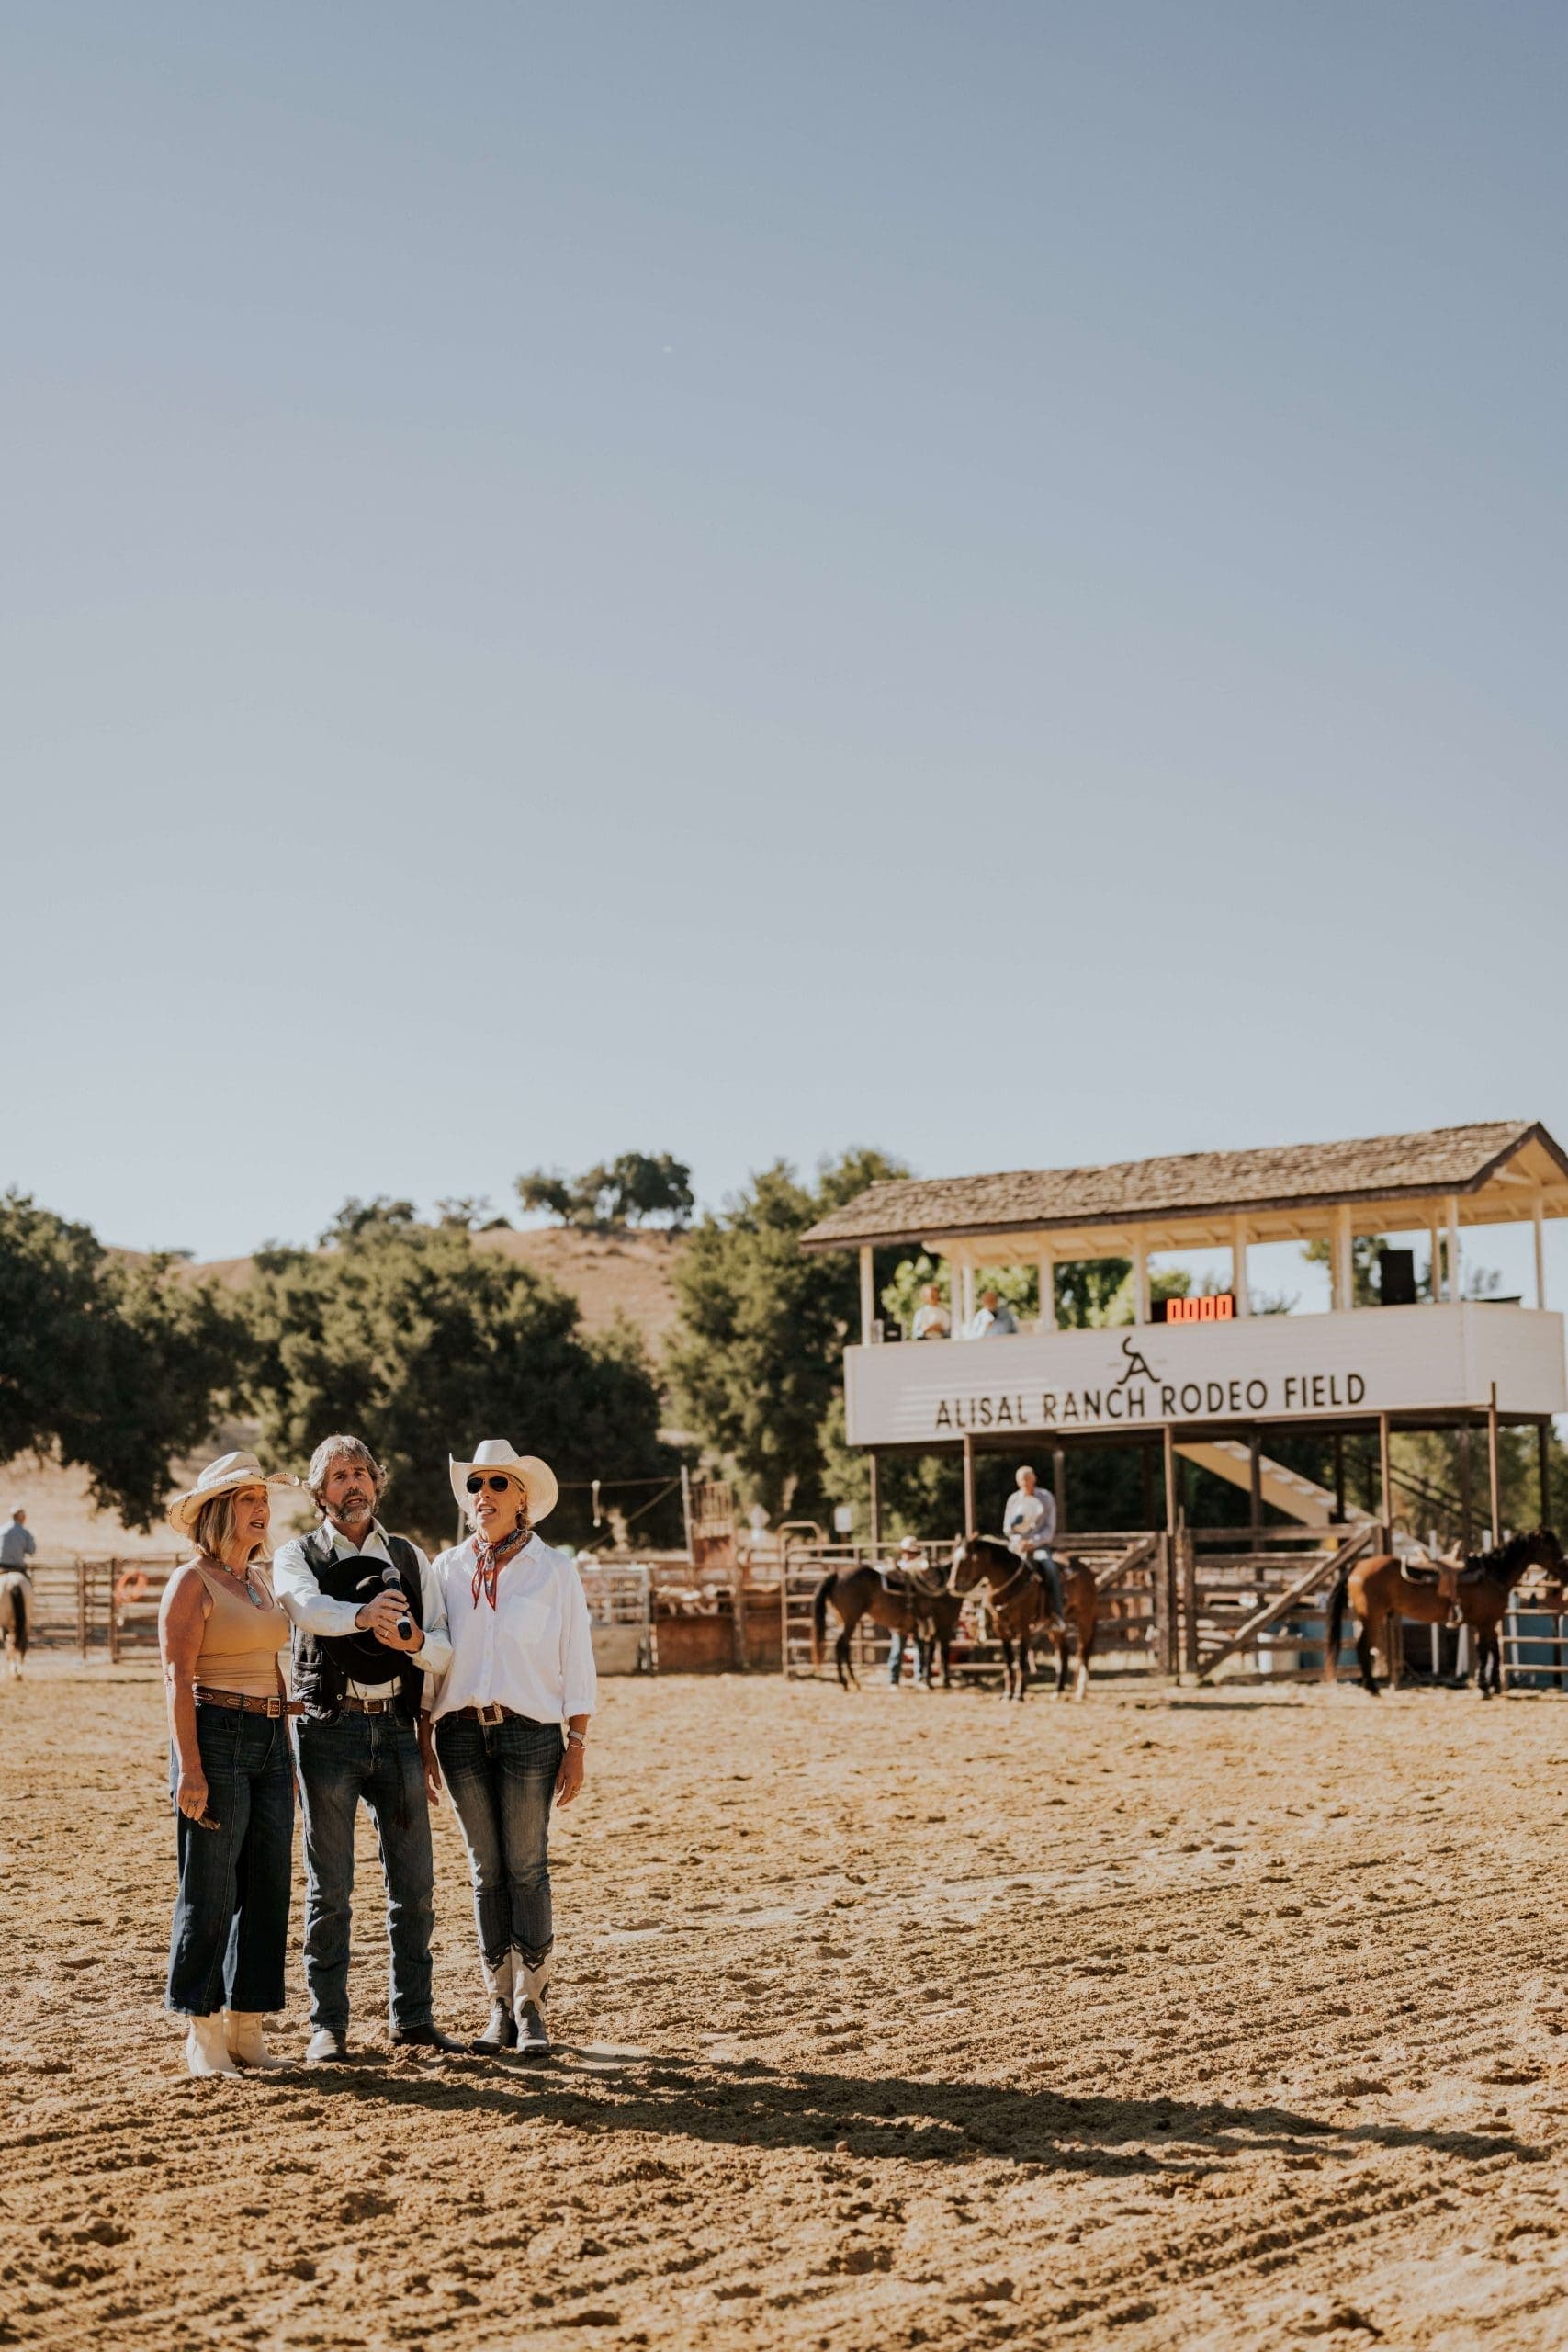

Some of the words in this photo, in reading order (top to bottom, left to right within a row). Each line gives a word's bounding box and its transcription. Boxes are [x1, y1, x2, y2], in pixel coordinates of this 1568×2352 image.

[936, 1396, 1028, 1429] ALISAL
[1043, 1386, 1145, 1422] RANCH
[1161, 1379, 1269, 1416] RODEO
[1284, 1374, 1366, 1408] FIELD
